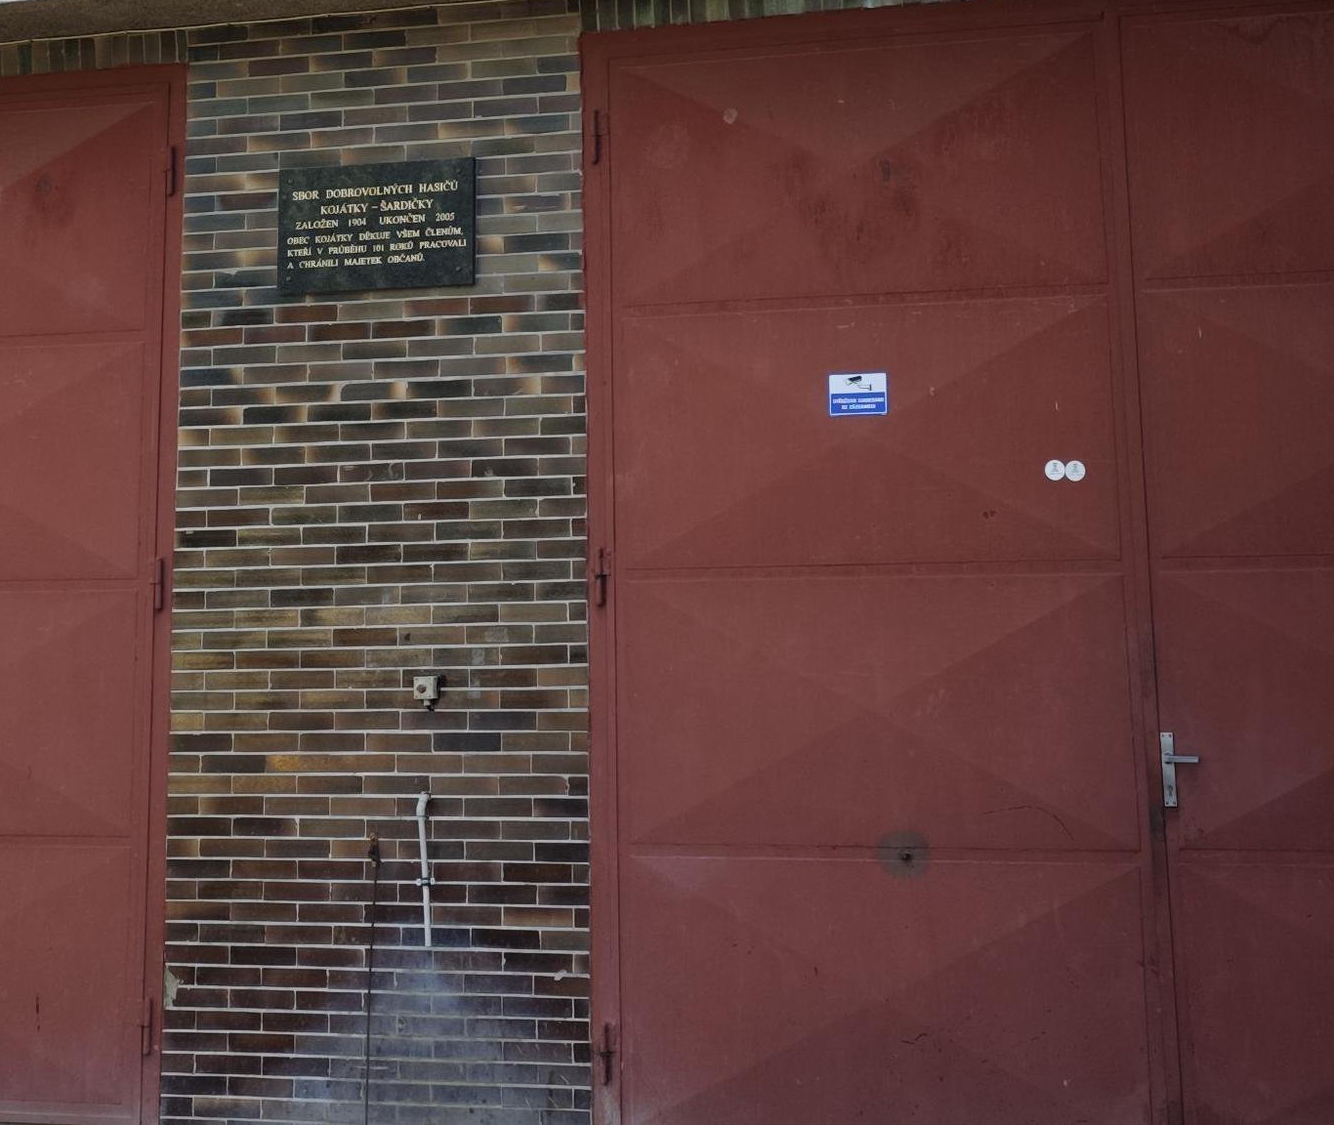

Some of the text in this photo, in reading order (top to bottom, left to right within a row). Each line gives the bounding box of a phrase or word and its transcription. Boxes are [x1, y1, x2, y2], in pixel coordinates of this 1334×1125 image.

[292, 180, 458, 201] SBOR DOBROVOLNÝCH HASIČŮ
[320, 203, 369, 215] KOJÁTKY
[380, 197, 434, 212] ŠARDIČKY
[295, 212, 455, 230] ZALOŽEN 1904 UKONČEN 2005
[287, 236, 310, 245] OBEC
[315, 232, 353, 244] KOJÁTKY
[396, 228, 420, 238] VŠEM
[287, 247, 312, 257] KTEŘÍ
[317, 247, 324, 255] V
[372, 244, 385, 252] 101
[419, 239, 467, 250] PRACOVALI
[287, 261, 294, 269] A
[299, 258, 339, 269] CHRÁNILI
[344, 256, 383, 266] MAJETEK
